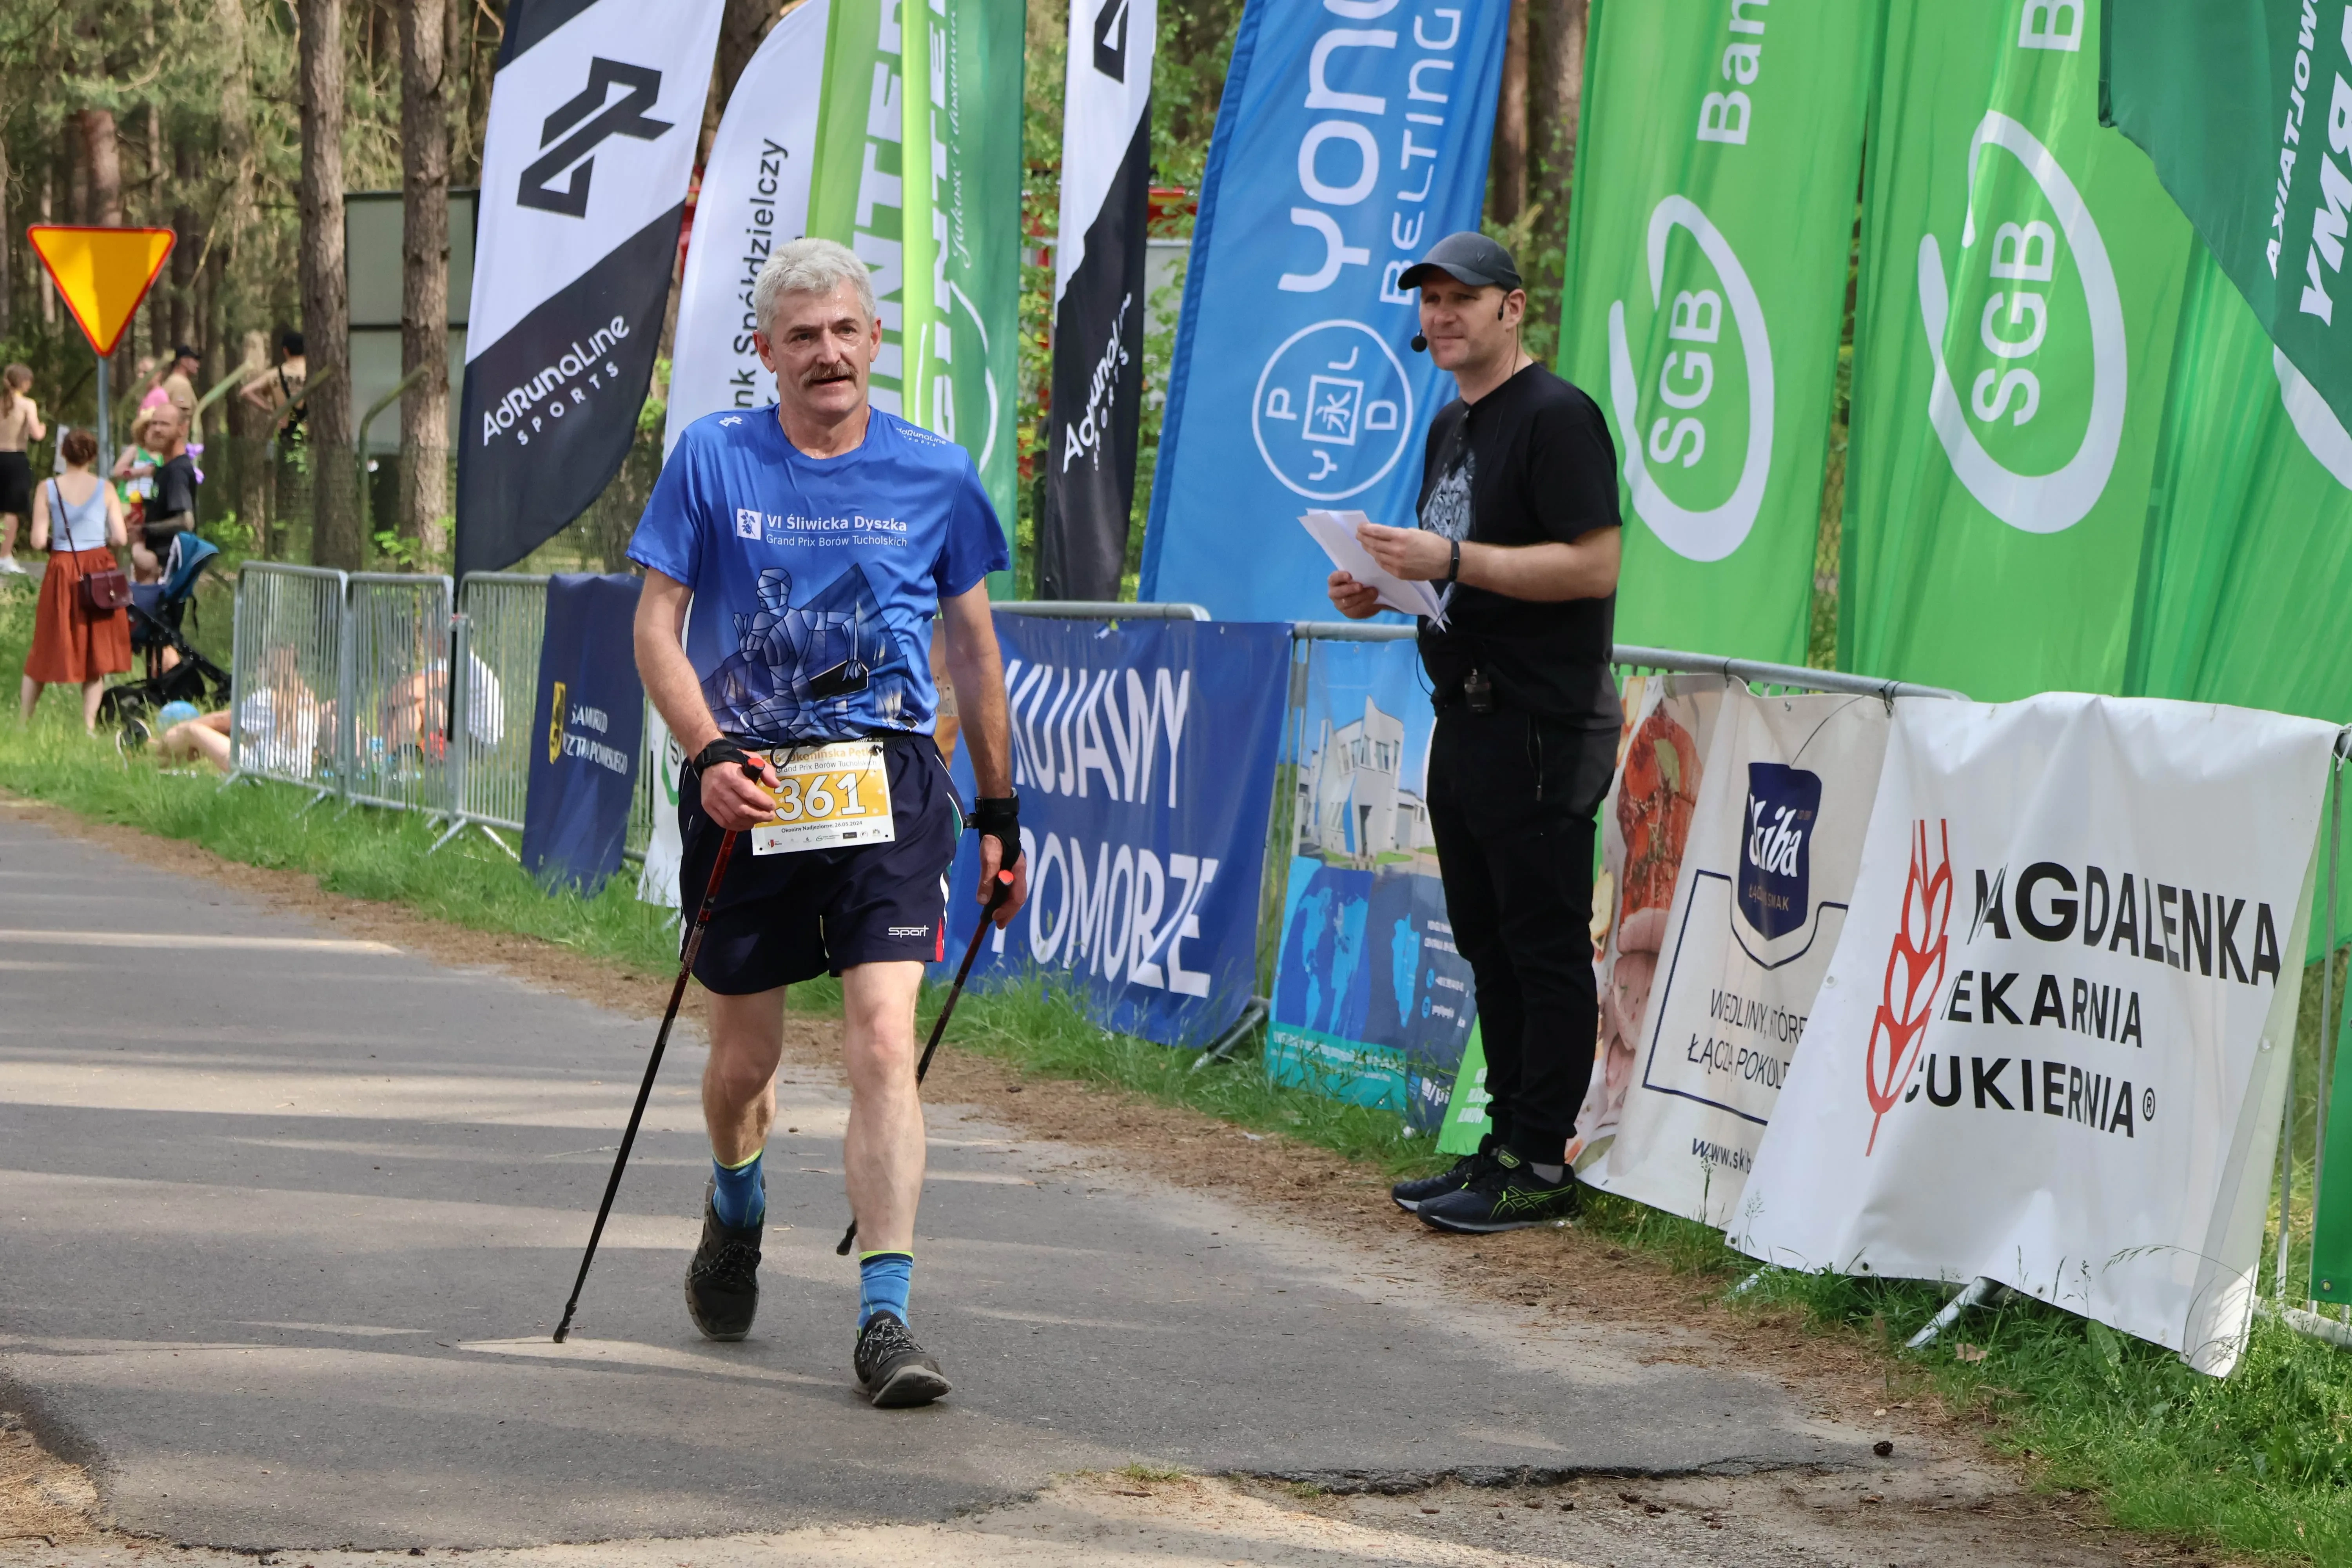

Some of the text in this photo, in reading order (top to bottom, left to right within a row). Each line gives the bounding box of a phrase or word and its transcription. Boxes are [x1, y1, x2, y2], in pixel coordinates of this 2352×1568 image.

[1278, 0, 1399, 292] yon
[928, 0, 955, 442] GINTE
[1972, 220, 2056, 426] SGB
[1327, 346, 1359, 371] L
[1649, 289, 1722, 468] SGB
[517, 361, 619, 446] SPORTS
[1265, 388, 1297, 421] P
[1365, 400, 1398, 430] D
[766, 534, 907, 547] Grand Prix Borów Tucholskich
[767, 514, 907, 532] VI Śliwicka Dyszka
[849, 746, 878, 759] Pętl
[1005, 659, 1190, 808] KUJAWY
[776, 765, 797, 773] Grand
[815, 760, 836, 769] Borów
[774, 772, 866, 821] 361
[1940, 970, 2142, 1048] EKARNIA
[1692, 1138, 1754, 1175] www.skib
